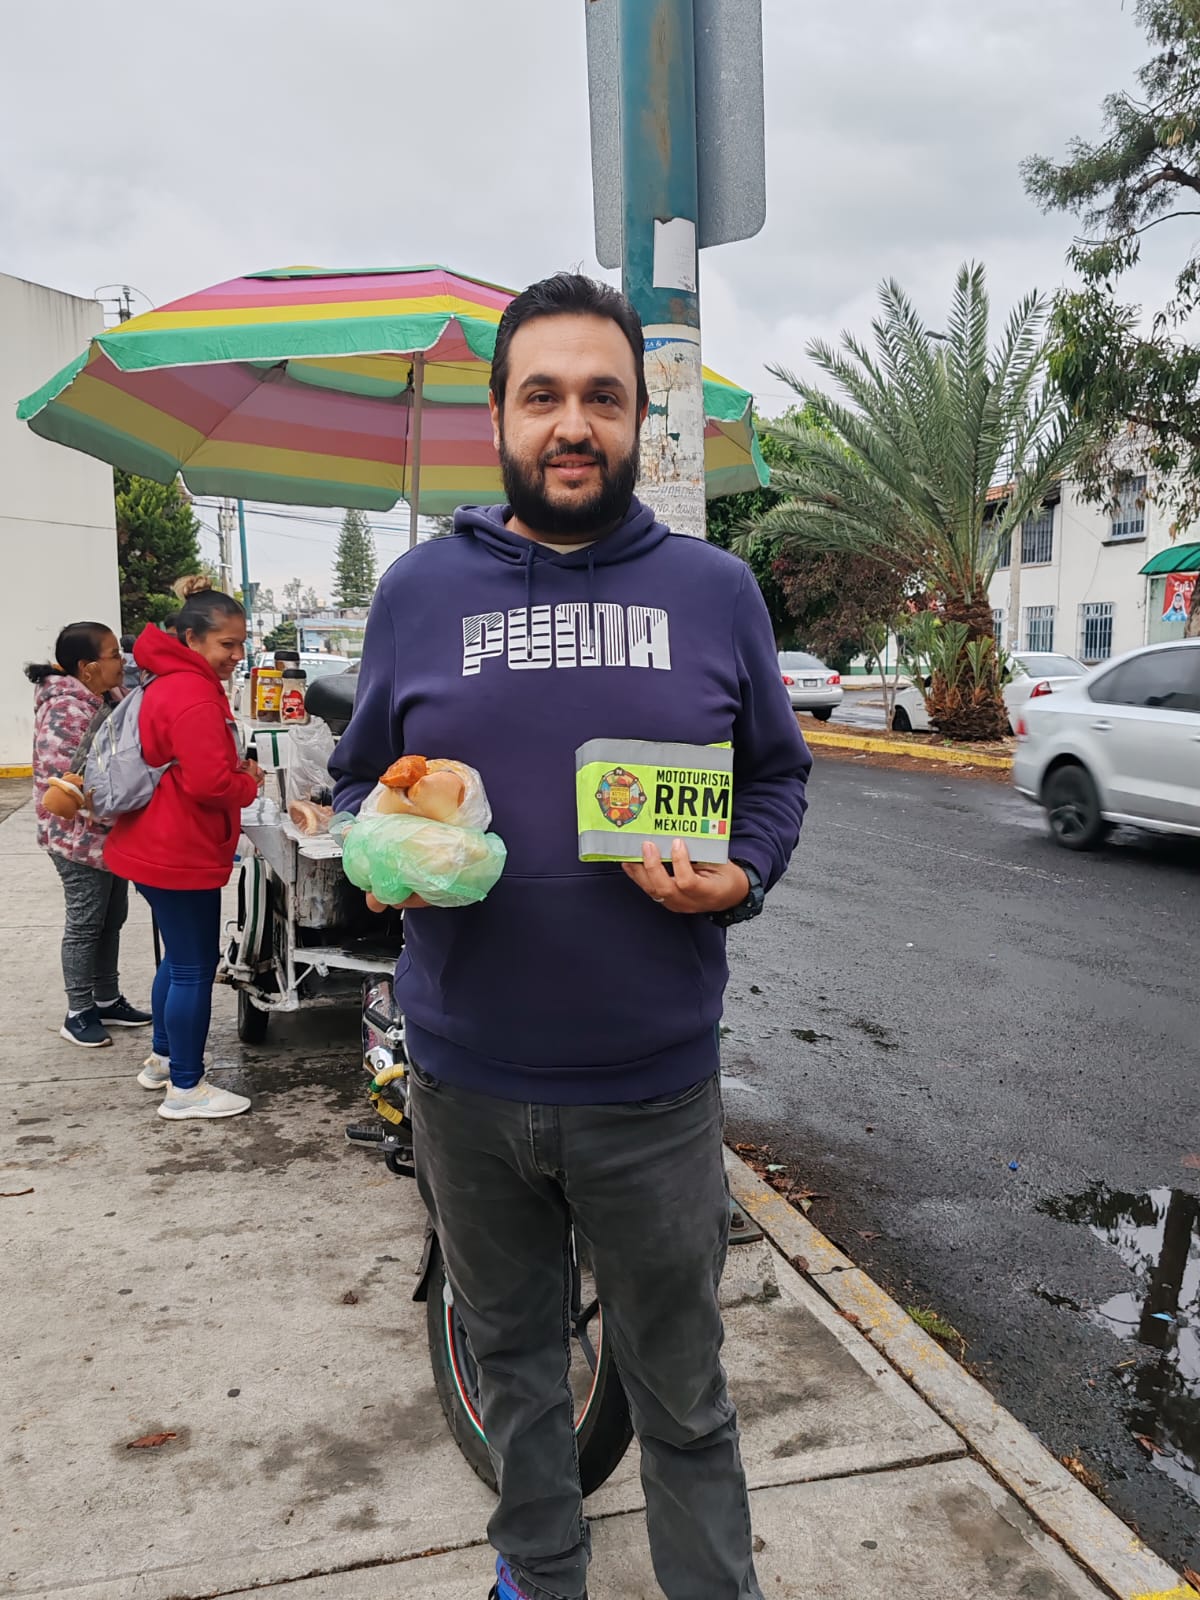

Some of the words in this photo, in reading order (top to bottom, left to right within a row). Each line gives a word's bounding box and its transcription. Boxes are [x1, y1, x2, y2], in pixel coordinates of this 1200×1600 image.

[462, 602, 671, 677] PUMA
[656, 769, 730, 787] MOTOTURISTA
[654, 784, 730, 819] RRM
[654, 816, 697, 832] MÉXICO
